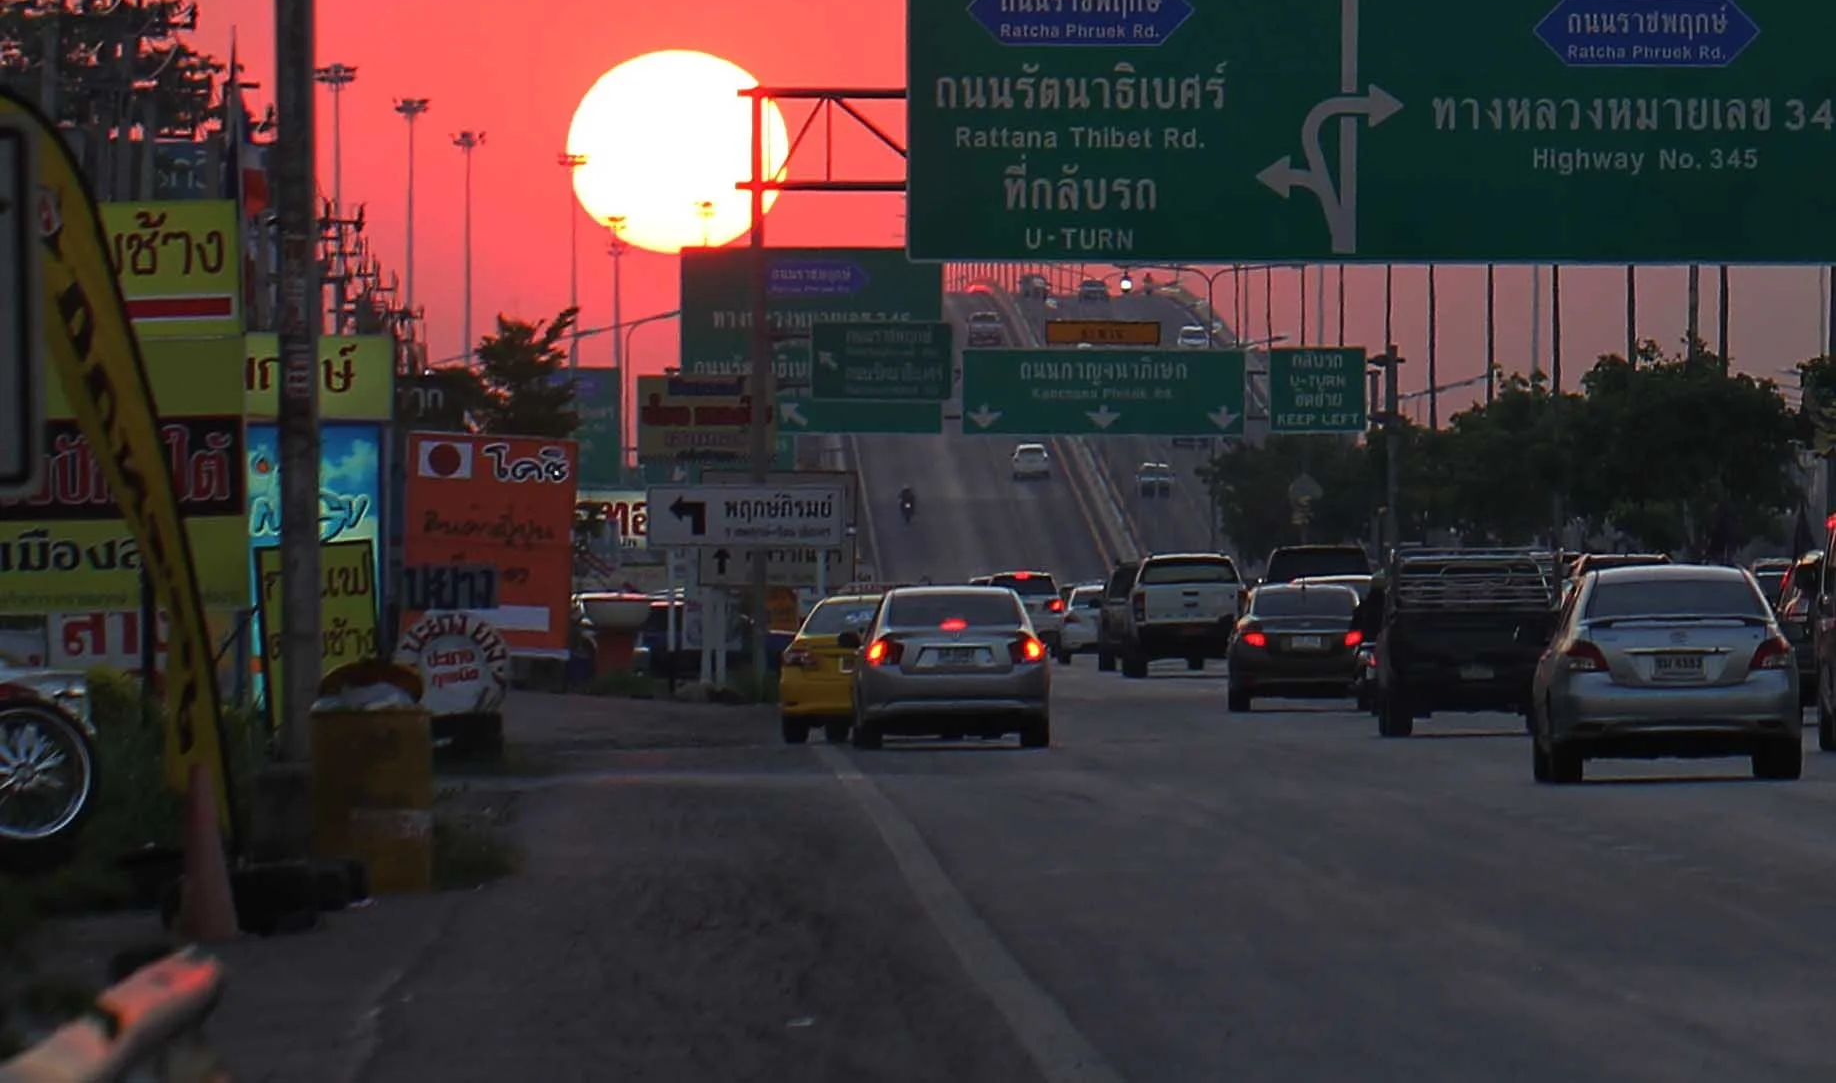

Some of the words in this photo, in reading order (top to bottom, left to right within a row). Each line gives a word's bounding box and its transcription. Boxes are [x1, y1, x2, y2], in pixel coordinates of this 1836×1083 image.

[1001, 23, 1060, 39] Ratcha
[1065, 23, 1126, 39] Phruek
[1132, 23, 1161, 39] Rd.
[1566, 4, 1728, 39] ถนนราชพฤกษ์
[1567, 44, 1627, 60] Ratcha
[1632, 44, 1693, 61] Phruek
[1699, 44, 1727, 61] Rd.
[935, 60, 1229, 110] ถนนรัตนาธิเบศร์
[1432, 96, 1772, 132] ทางหลวงหมายเลข
[955, 126, 1058, 149] Rattana
[1069, 126, 1153, 149] Thibet
[1163, 126, 1206, 149] Rd.
[1532, 148, 1645, 175] Highway
[1658, 148, 1703, 171] No.
[1709, 148, 1759, 171] 345
[1003, 153, 1158, 211] ที่กลับรถ
[1277, 412, 1316, 426] KEEP
[1321, 412, 1361, 426] LEFT
[724, 493, 834, 524] พฤกษ์ภิรมย์
